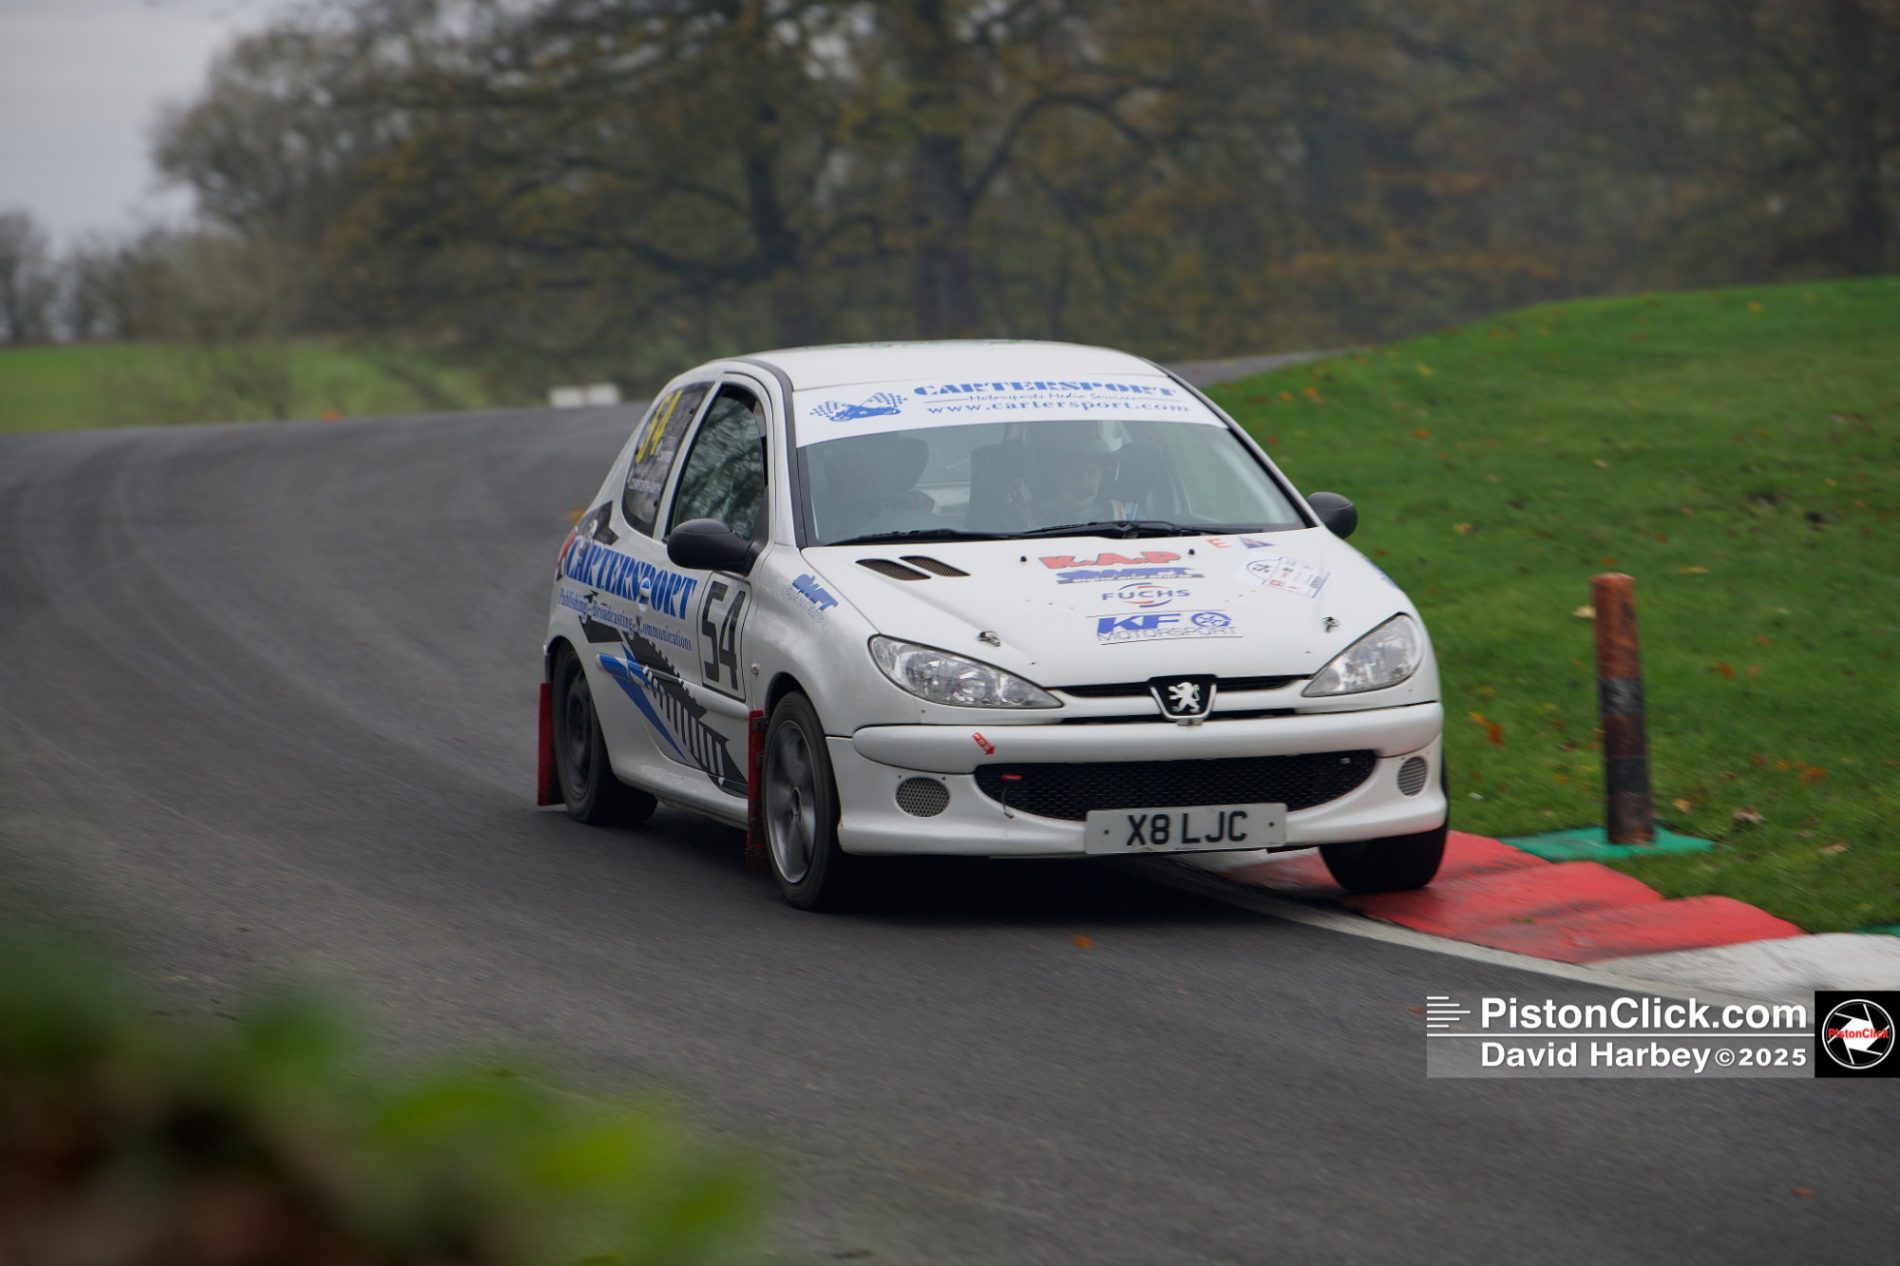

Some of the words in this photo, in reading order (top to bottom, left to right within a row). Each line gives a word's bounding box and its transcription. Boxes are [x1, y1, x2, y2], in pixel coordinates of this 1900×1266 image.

[914, 381, 1176, 396] CARTERSPORT
[928, 400, 1190, 413] www.cartersport.com
[565, 539, 697, 620] CARTERSPORT
[1102, 589, 1191, 601] FUCHS
[1097, 613, 1182, 634] KF
[702, 581, 746, 690] 54
[1097, 626, 1237, 642] MOTORSPORT
[1126, 814, 1170, 846] X8
[1181, 810, 1248, 845] LJC
